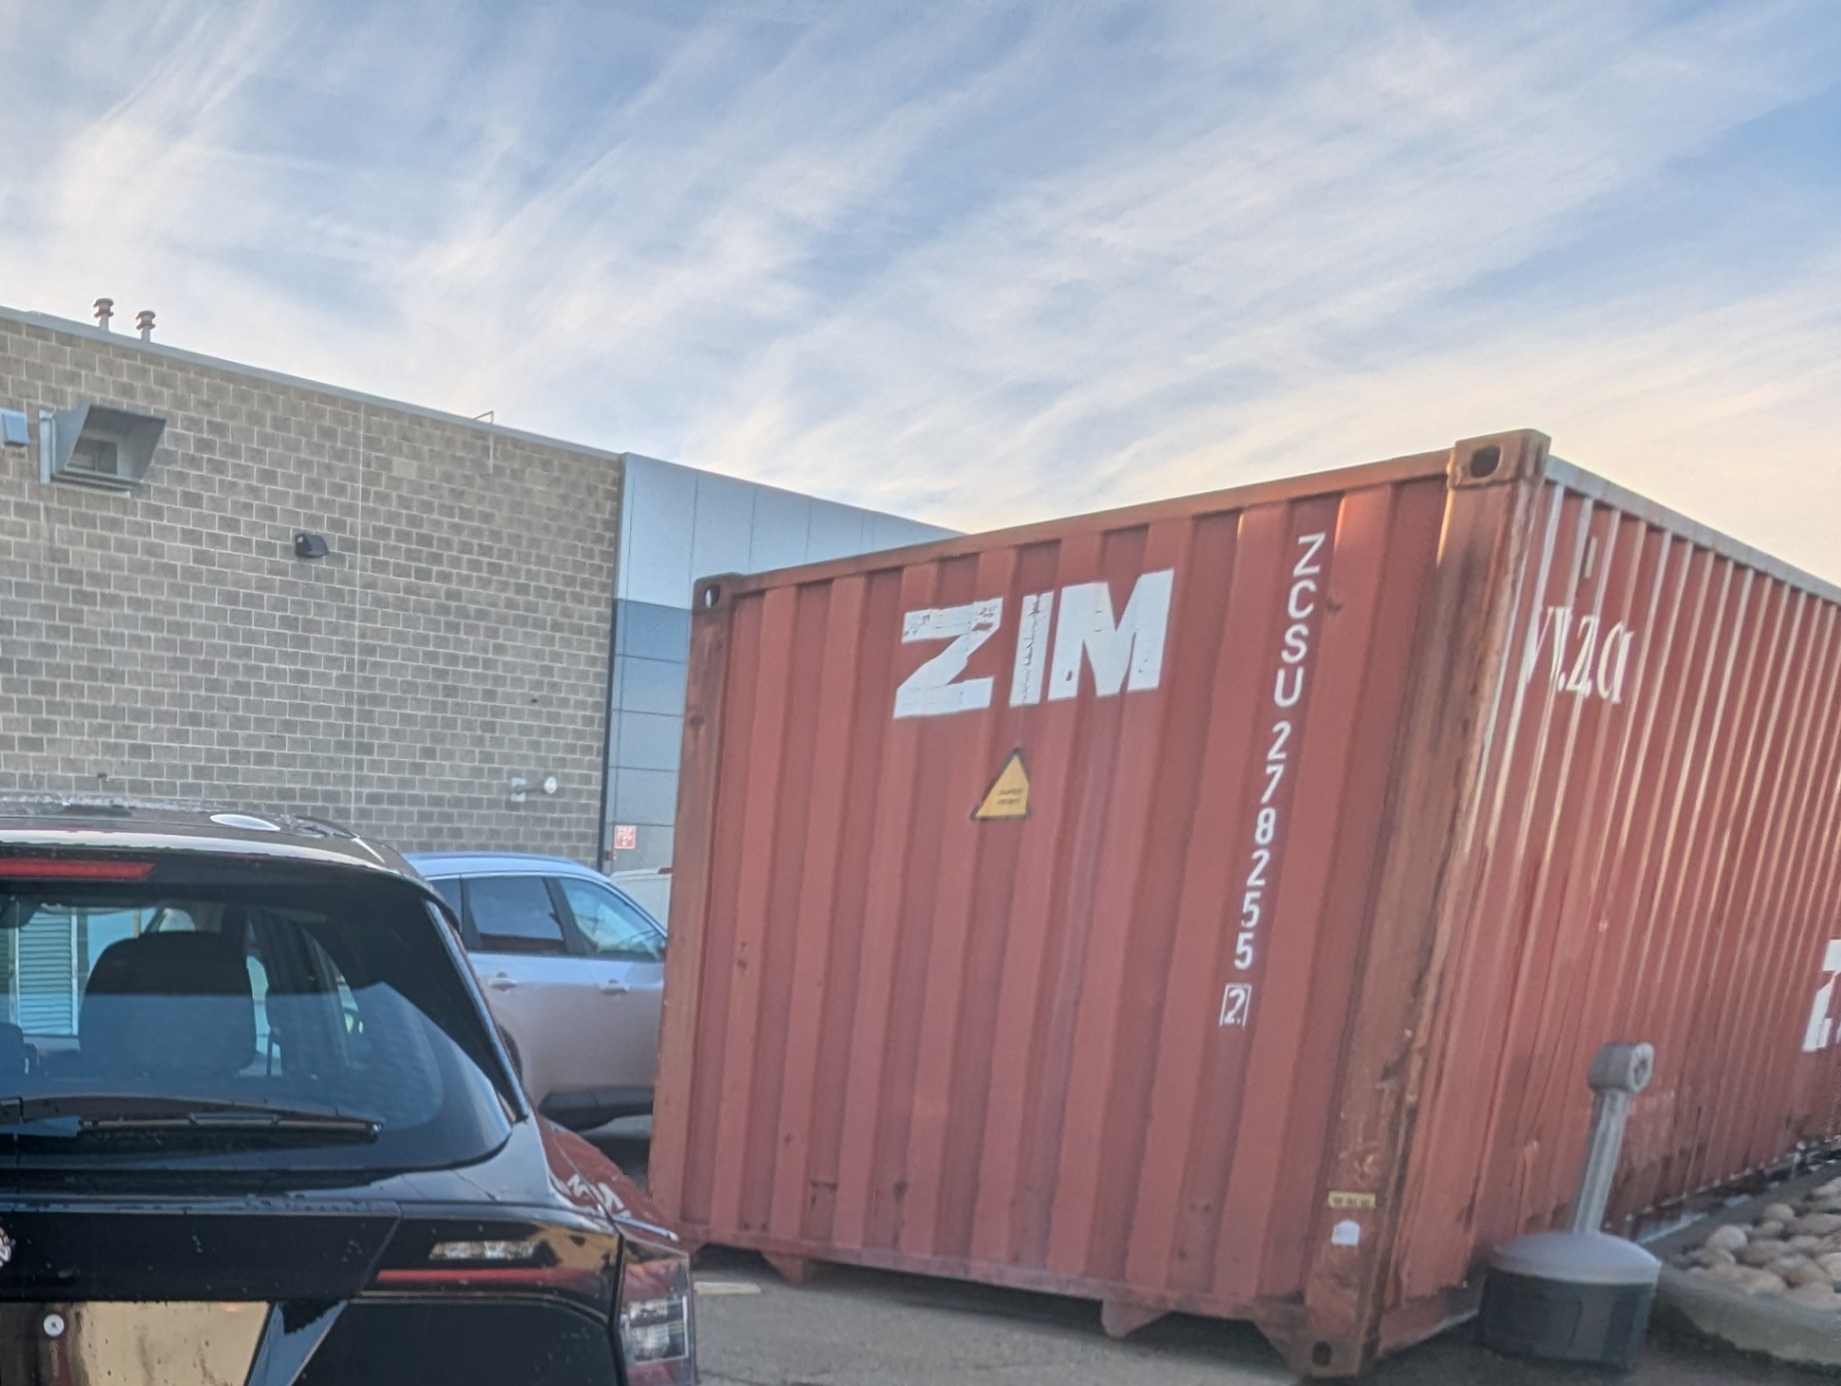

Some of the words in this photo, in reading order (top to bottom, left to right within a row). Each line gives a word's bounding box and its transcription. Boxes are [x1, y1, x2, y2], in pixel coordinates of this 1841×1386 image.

[893, 568, 1175, 719] ZIM
[1273, 531, 1327, 708] ZCSU
[1234, 720, 1292, 970] 278255
